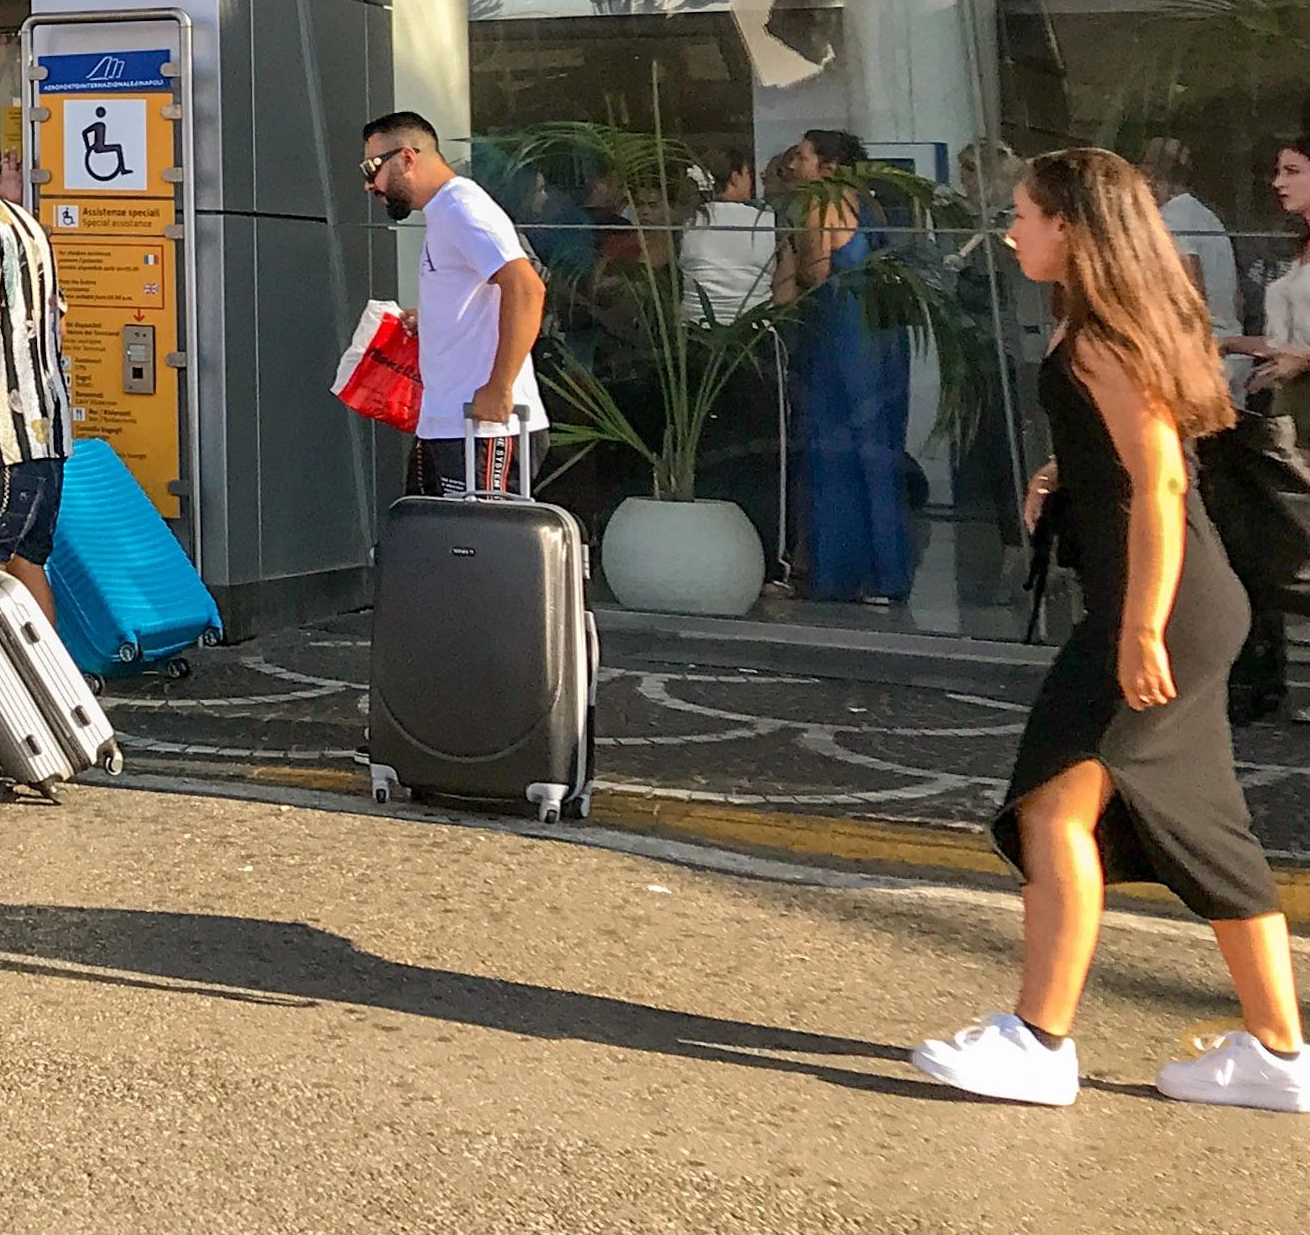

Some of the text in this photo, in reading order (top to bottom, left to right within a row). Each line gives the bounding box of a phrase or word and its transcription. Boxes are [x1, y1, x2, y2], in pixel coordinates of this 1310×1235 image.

[82, 207, 161, 219] Assistenze speciali
[82, 218, 111, 228] Special
[493, 449, 505, 493] SYSTEM
